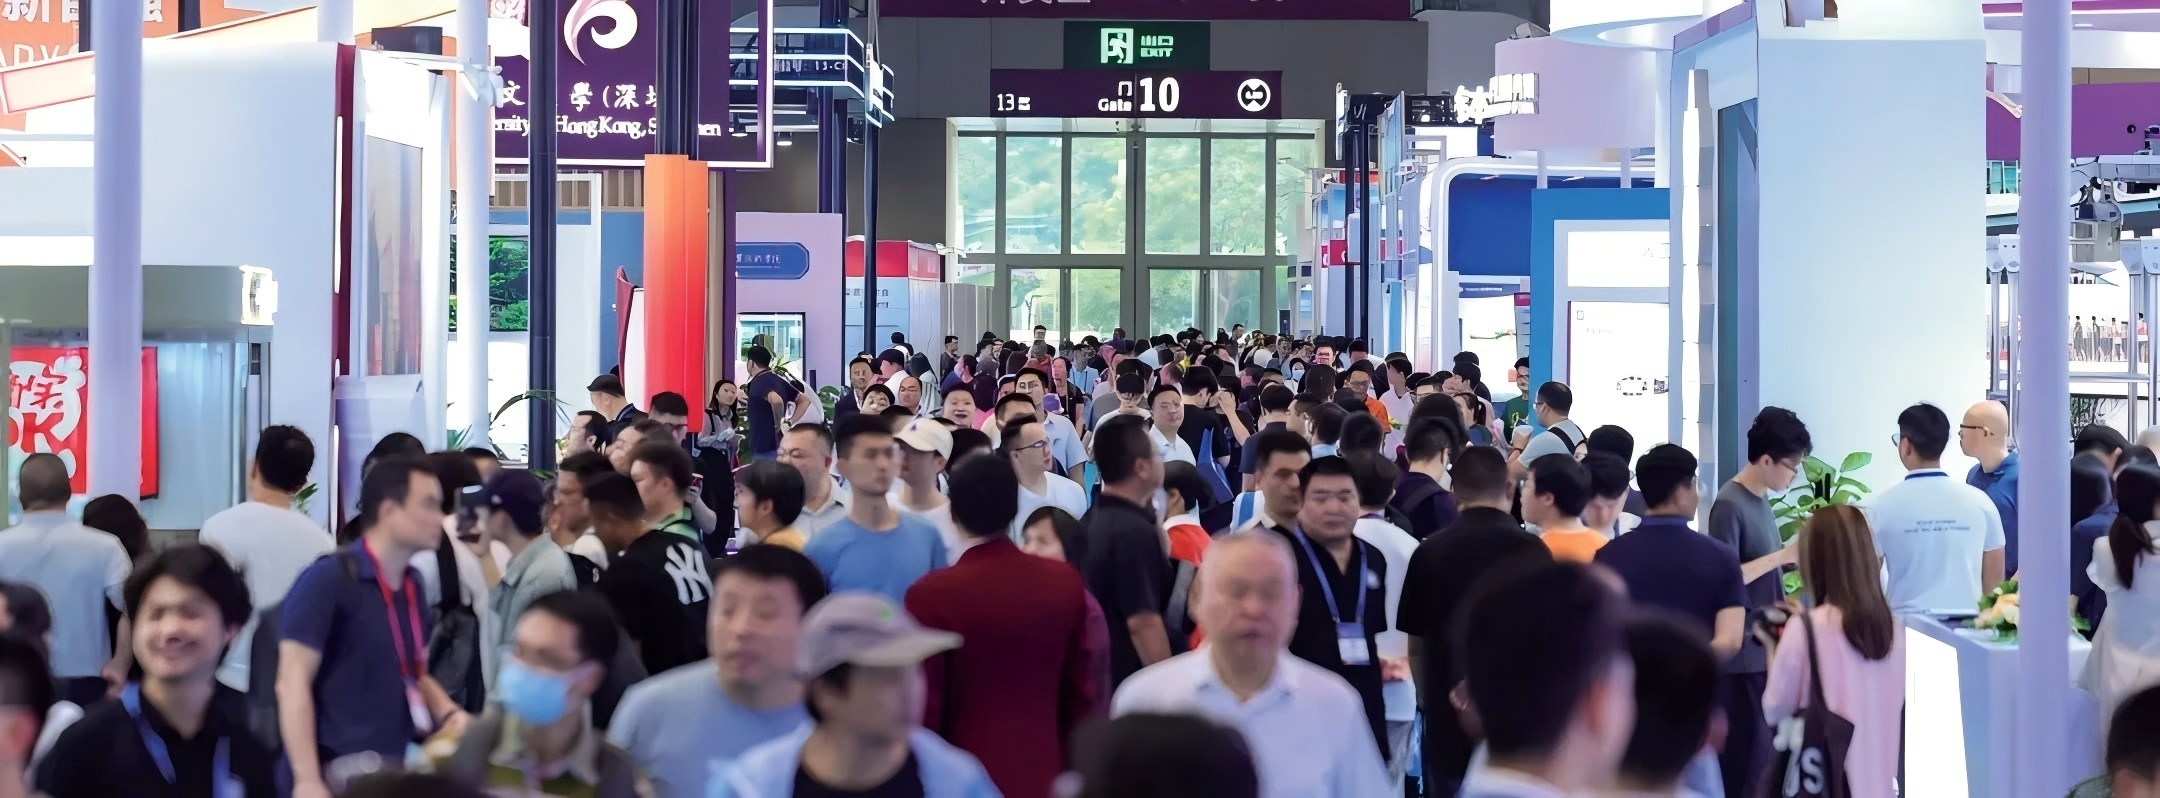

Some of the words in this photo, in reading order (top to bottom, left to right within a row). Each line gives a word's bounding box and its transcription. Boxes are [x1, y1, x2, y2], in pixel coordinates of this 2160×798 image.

[997, 93, 1015, 111] 13
[1098, 98, 1132, 112] Gate
[1139, 76, 1180, 112] 10
